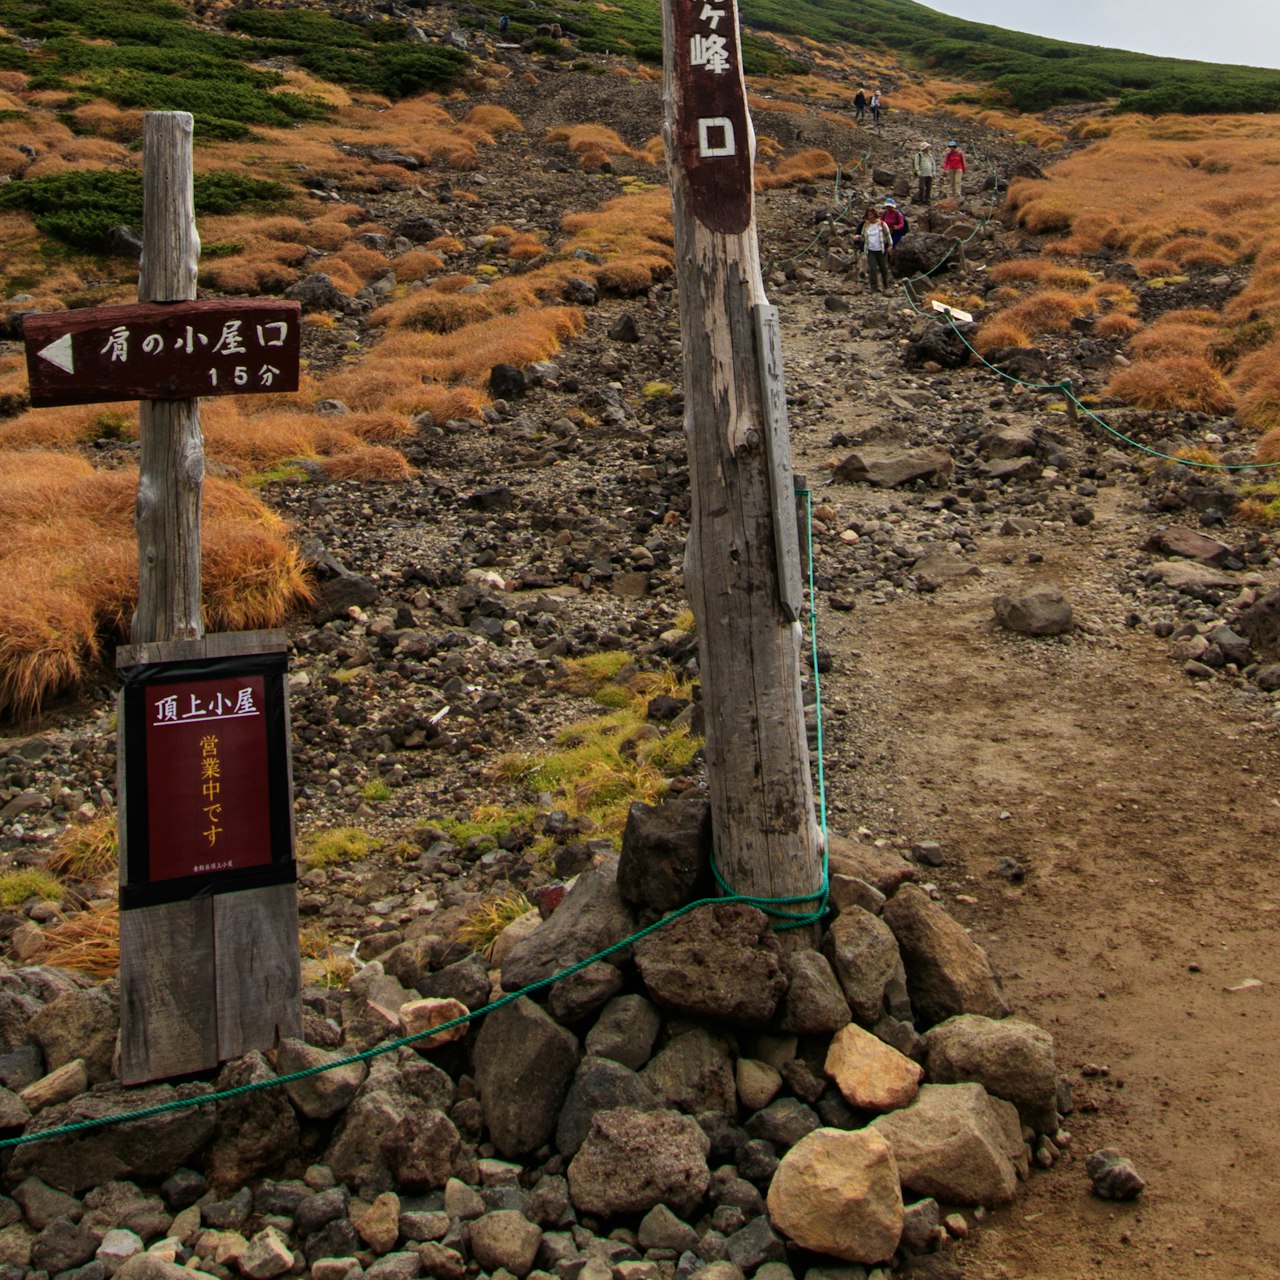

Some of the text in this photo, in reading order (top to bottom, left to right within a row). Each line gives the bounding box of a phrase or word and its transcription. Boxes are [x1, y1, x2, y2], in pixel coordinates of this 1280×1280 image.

[100, 320, 288, 362] 肩の小屋口
[208, 364, 280, 386] 15分
[154, 687, 257, 721] 頂上小屋
[199, 734, 223, 847] 営業中です
